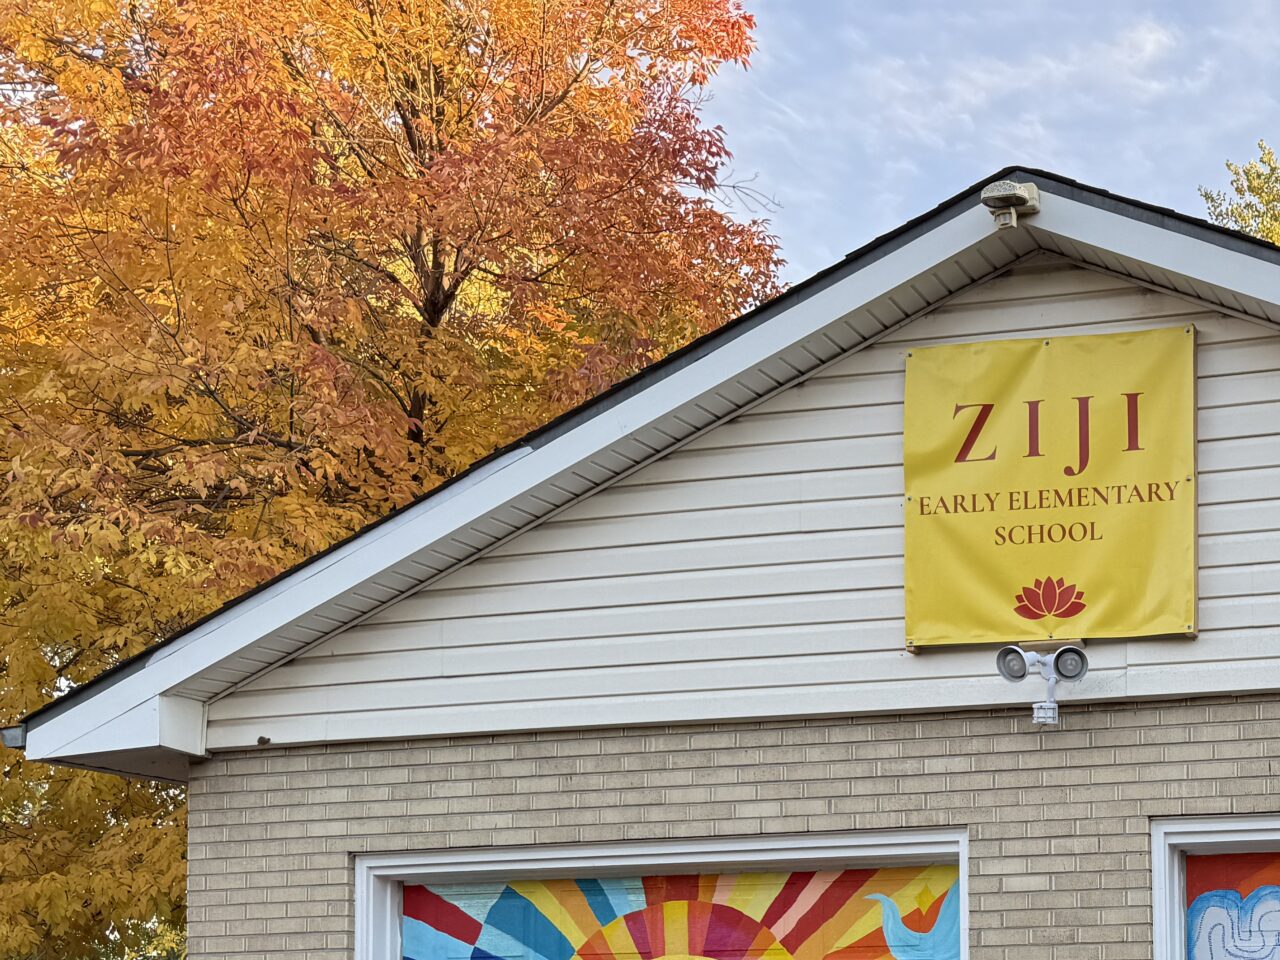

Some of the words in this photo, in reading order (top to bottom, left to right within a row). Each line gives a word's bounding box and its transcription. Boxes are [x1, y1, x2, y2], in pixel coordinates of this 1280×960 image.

[952, 392, 1145, 477] ZIJI
[919, 492, 1000, 516] EARLY
[1008, 481, 1180, 511] ELEMENTARY
[994, 522, 1103, 546] SCHOOL
